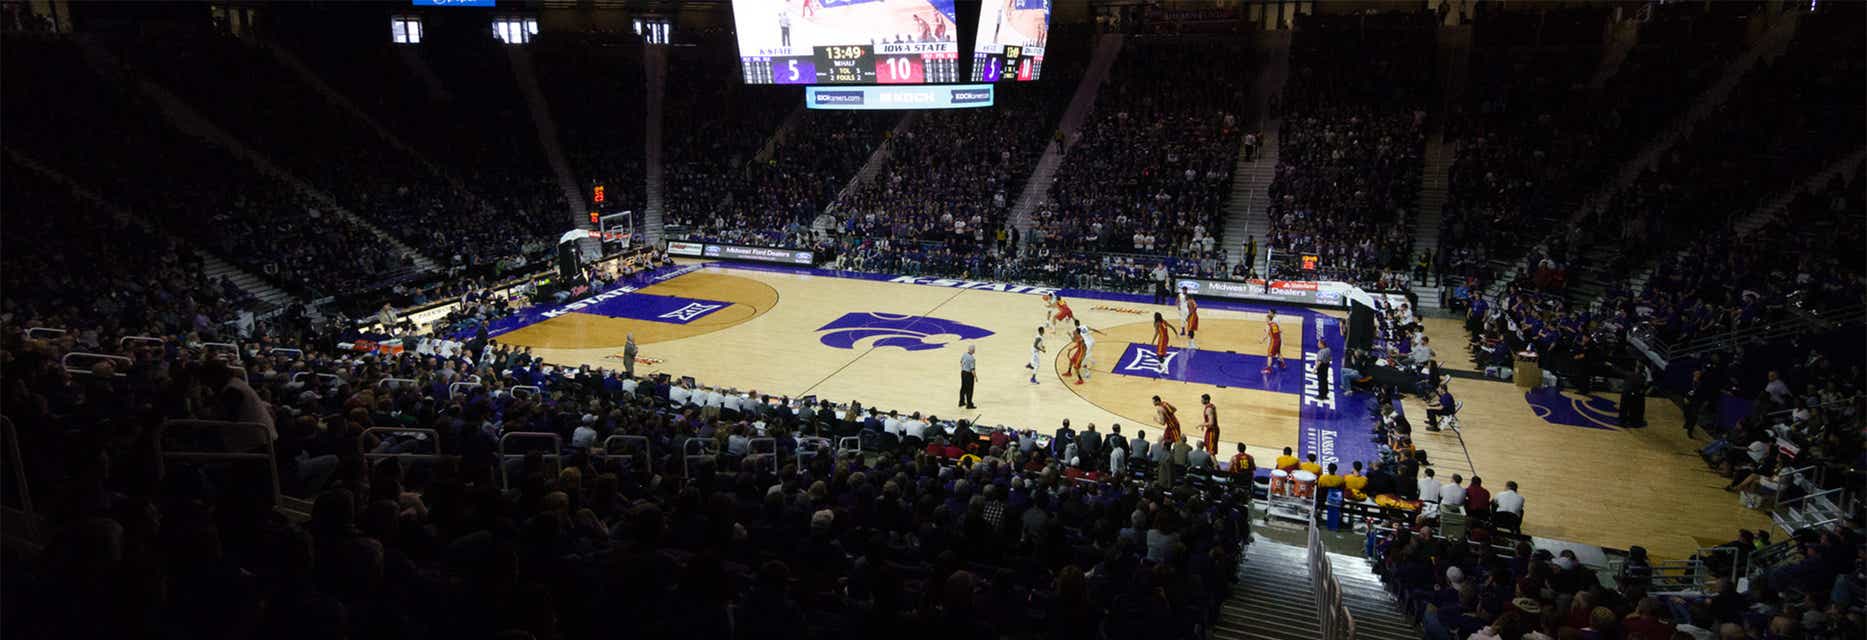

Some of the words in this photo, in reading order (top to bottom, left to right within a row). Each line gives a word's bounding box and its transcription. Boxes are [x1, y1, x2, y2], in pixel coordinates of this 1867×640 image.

[826, 46, 861, 60] 13:49
[883, 45, 911, 53] IOWA
[914, 44, 948, 52] STATE
[788, 59, 800, 81] 5
[886, 57, 912, 81] 10
[726, 246, 752, 255] Midwest
[752, 248, 767, 256] Ford
[766, 250, 791, 258] Dealers
[889, 275, 1061, 295] K-STATE
[1208, 282, 1247, 292] Midwest
[1271, 287, 1307, 297] Dealers
[540, 285, 639, 318] K-STATE
